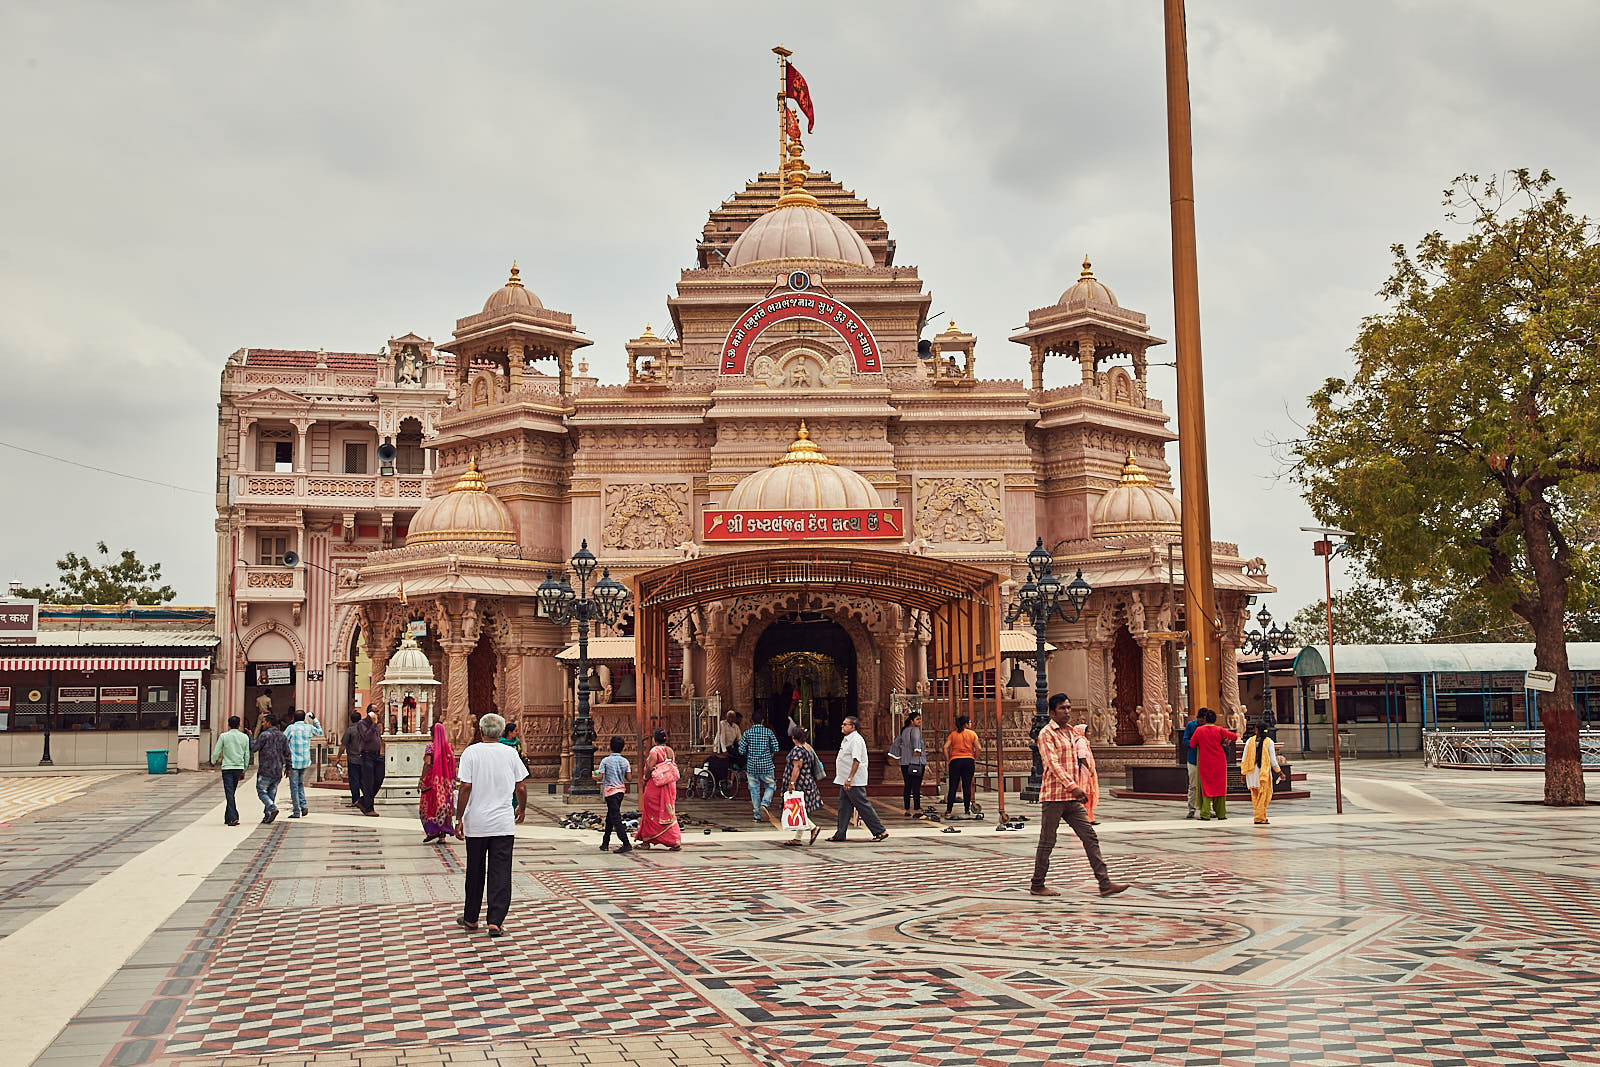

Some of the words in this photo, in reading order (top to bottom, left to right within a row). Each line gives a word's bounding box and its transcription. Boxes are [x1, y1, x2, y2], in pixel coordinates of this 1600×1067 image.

[731, 328, 746, 347] નમો
[743, 305, 767, 330] હનુમતે
[767, 297, 815, 313] ભયભંજનાય
[727, 513, 744, 533] શ્રી
[747, 515, 805, 533] કષ્ટભંજન
[832, 517, 862, 531] સત્ય
[9, 613, 29, 624] कक्ष
